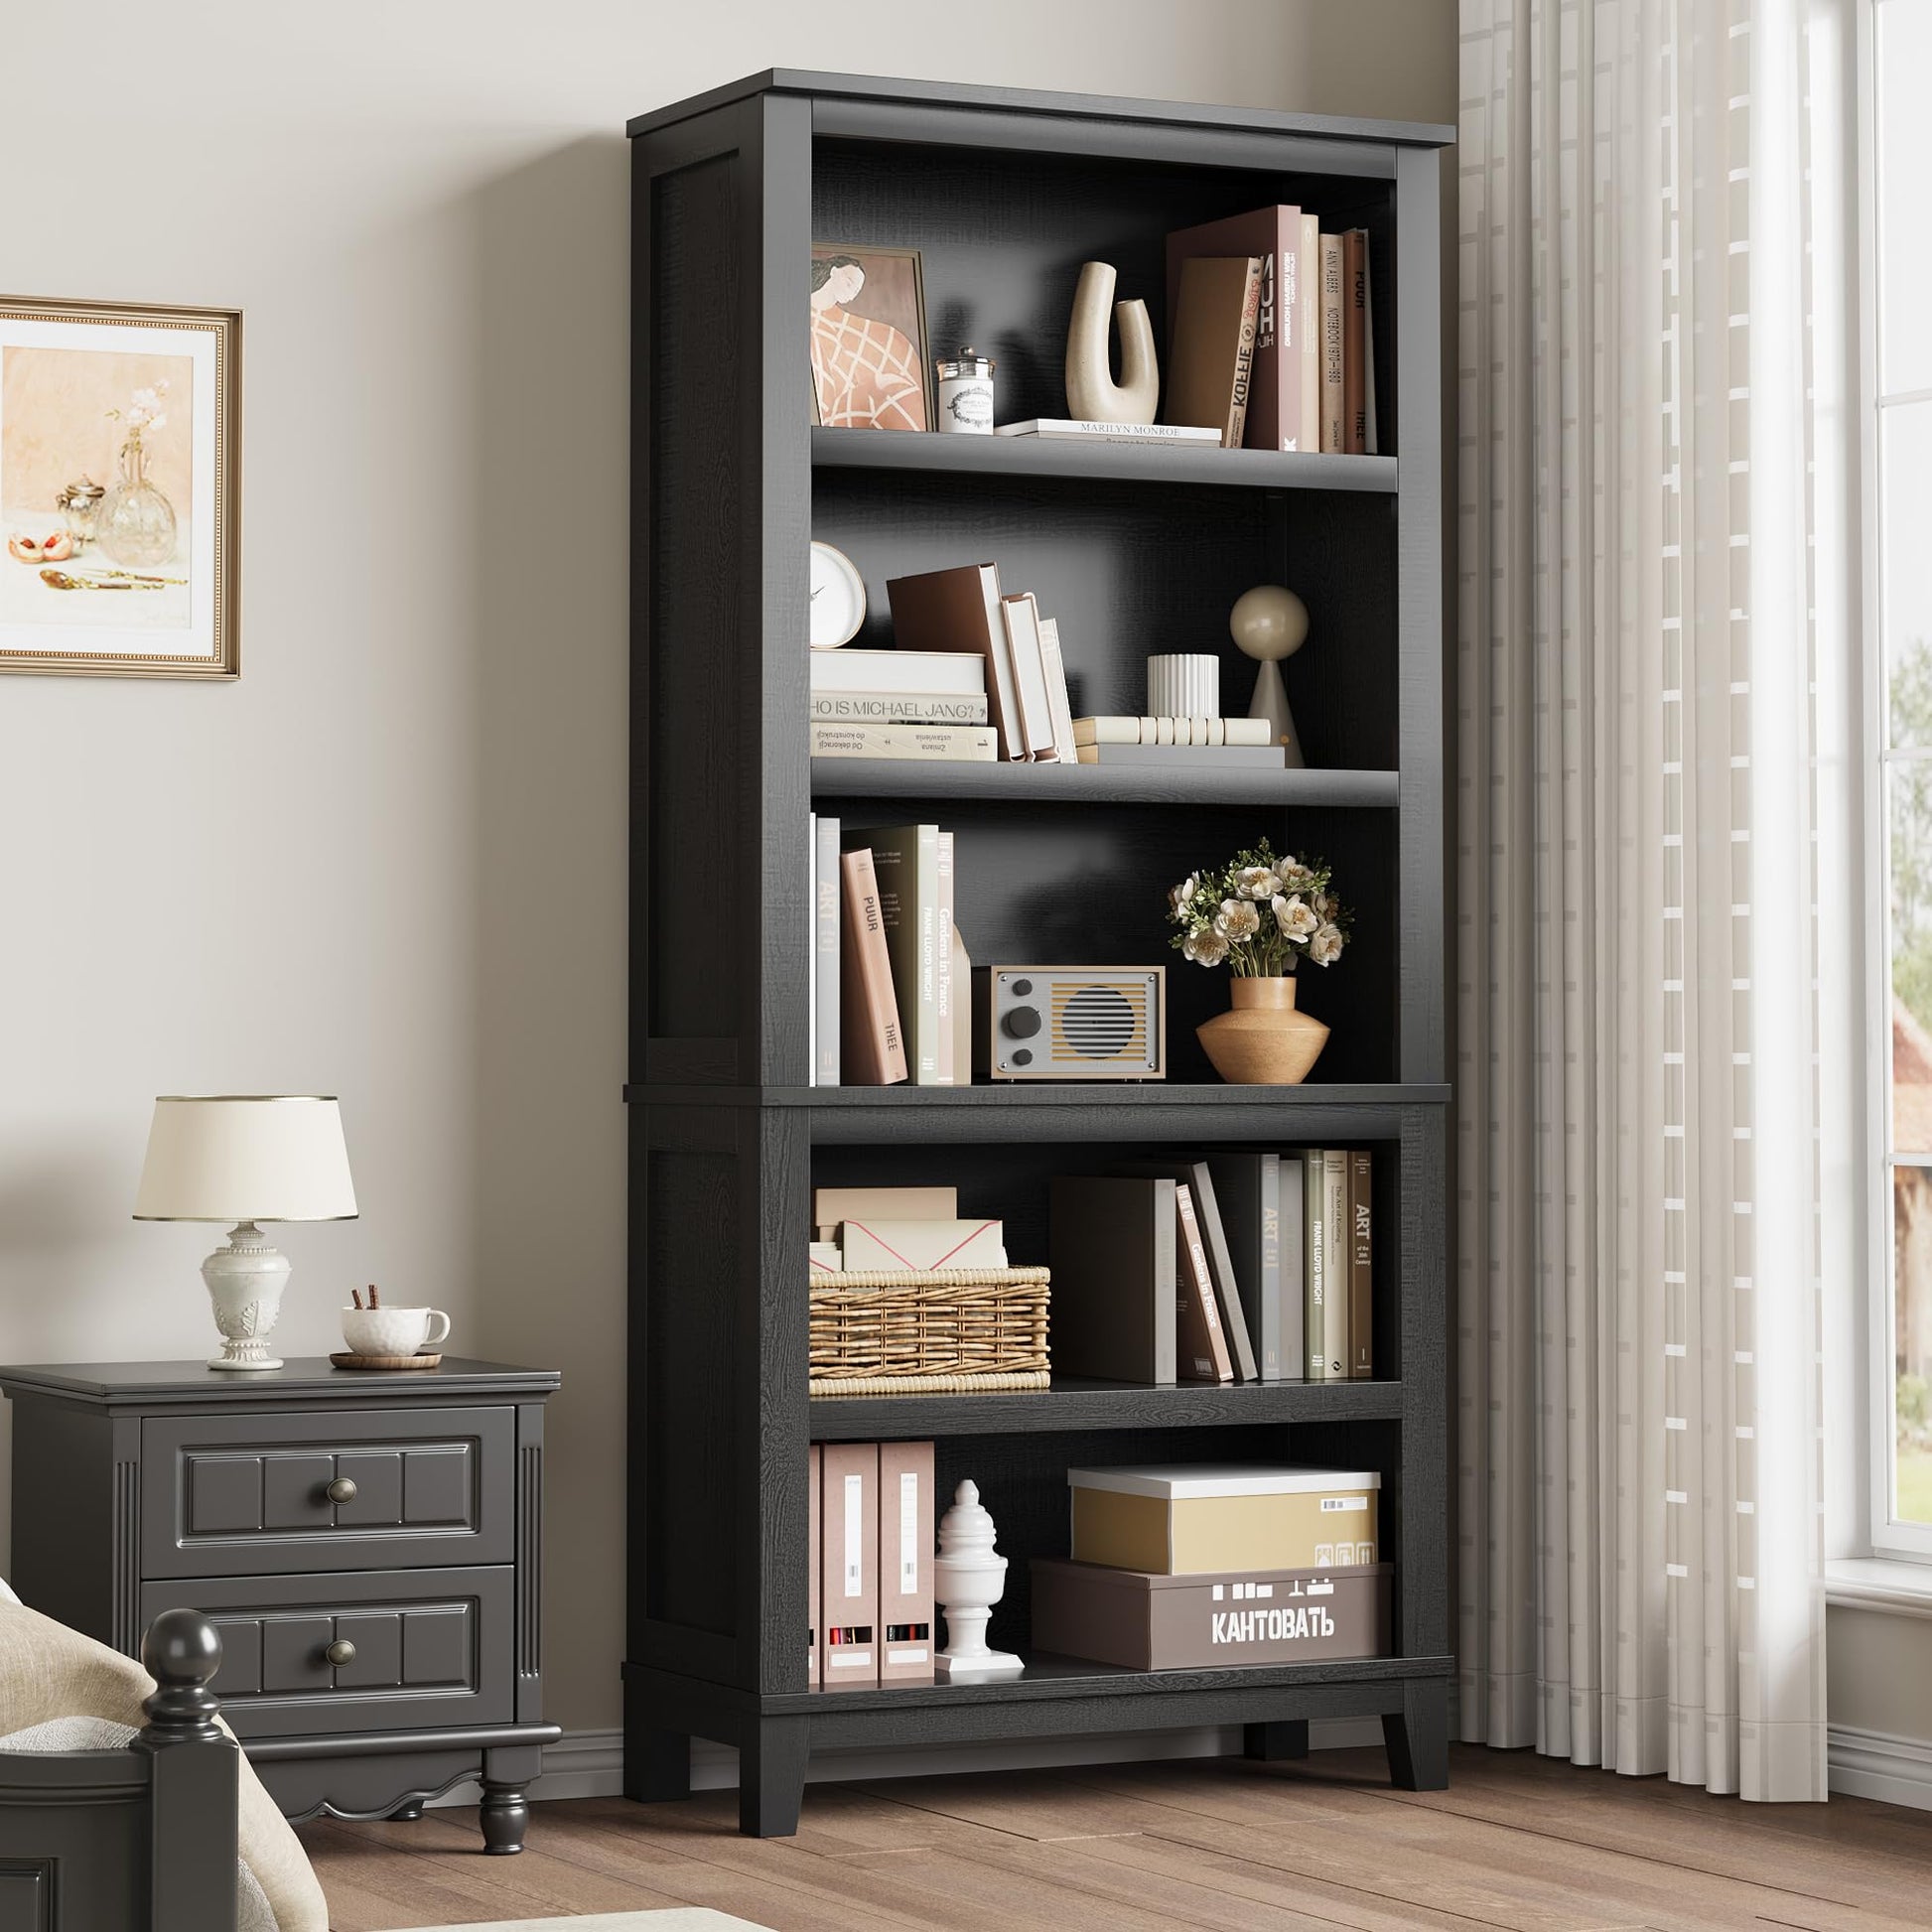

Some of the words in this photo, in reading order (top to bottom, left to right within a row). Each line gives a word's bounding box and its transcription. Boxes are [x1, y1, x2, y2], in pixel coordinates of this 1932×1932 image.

[1326, 249, 1337, 268] ANNI
[1326, 269, 1338, 294] ALBERS
[1327, 307, 1339, 345] NOTEBOOK
[1081, 423, 1131, 434] MARILYN
[1134, 425, 1179, 436] MONROE
[835, 700, 850, 715] IS
[853, 701, 922, 717] MICHAEL
[924, 703, 974, 718] JANG?
[817, 730, 855, 740] konstrukcji
[853, 742, 863, 751] Od
[923, 906, 932, 934] FRANK
[939, 907, 950, 958] Gardens
[923, 937, 932, 965] LLOYD
[864, 896, 879, 931] PUUR
[885, 1022, 898, 1051] THEE
[939, 960, 950, 972] in
[923, 966, 932, 1002] WRIGHT
[938, 975, 950, 1017] France
[1264, 1207, 1279, 1243] ART
[1313, 1220, 1322, 1246] FRANK
[1356, 1203, 1370, 1240] ART
[1191, 1243, 1206, 1283] Gardens
[1313, 1248, 1322, 1273] LLOYD
[1200, 1283, 1210, 1294] in
[1313, 1274, 1322, 1306] WRIGHT
[1203, 1295, 1216, 1328] France
[1212, 1606, 1334, 1644] КАНТОВАТЬ
